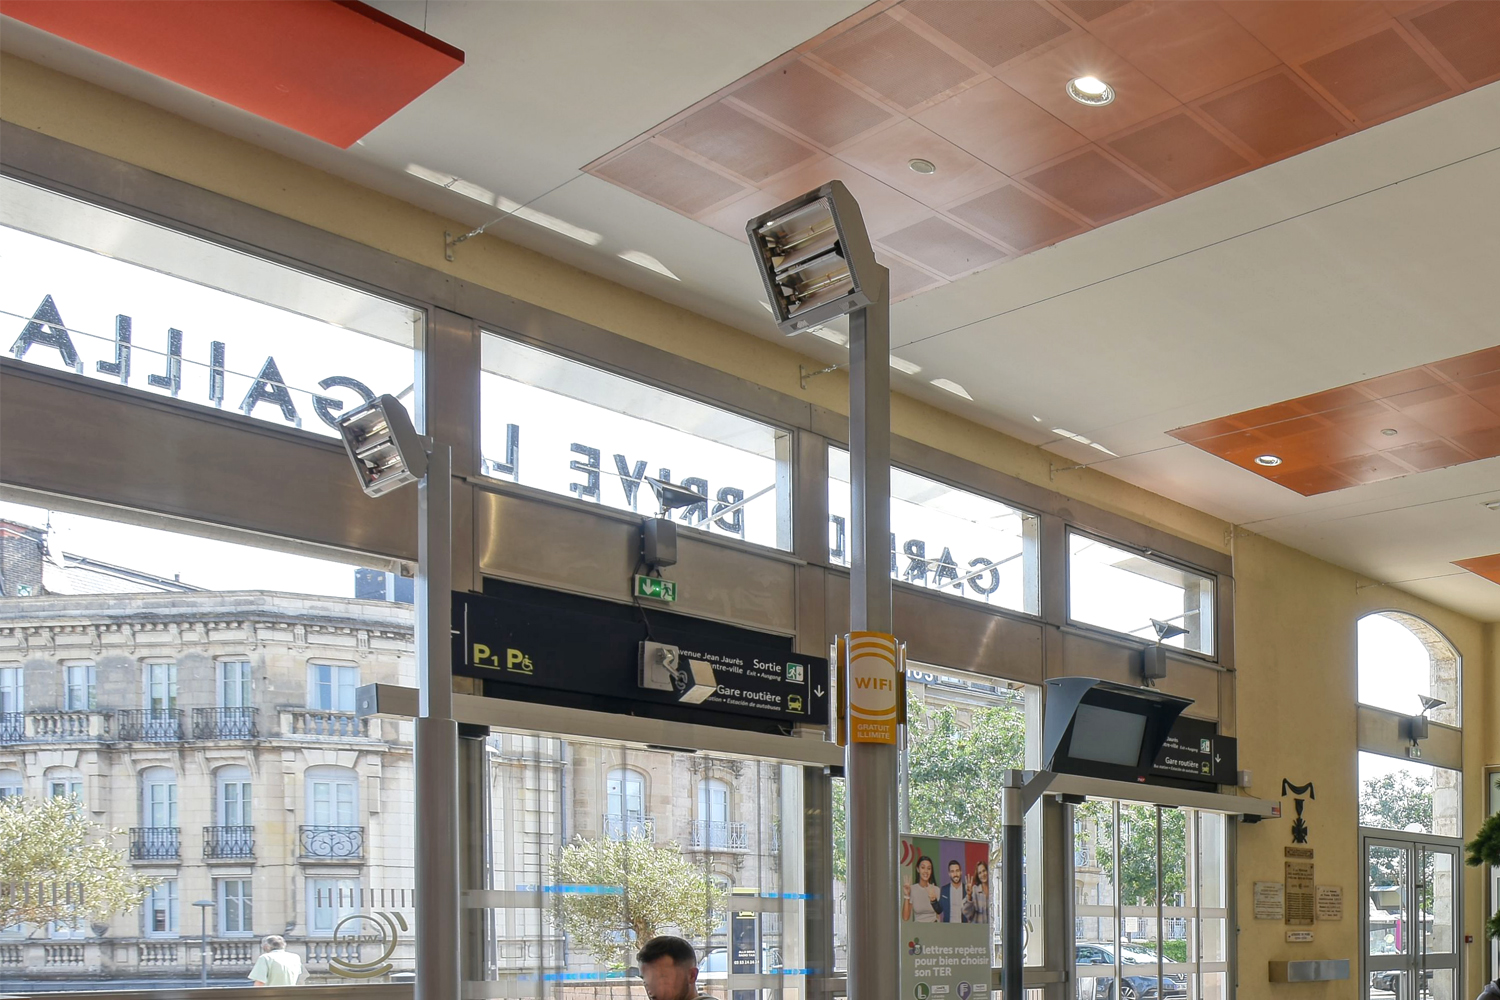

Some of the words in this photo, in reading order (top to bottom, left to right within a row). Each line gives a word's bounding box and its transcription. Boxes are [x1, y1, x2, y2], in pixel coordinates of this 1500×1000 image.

[678, 649, 702, 659] venue
[702, 652, 720, 662] Jean
[720, 655, 744, 666] Jaurès
[711, 663, 744, 675] ntre-ville
[753, 659, 782, 673] Sortie
[746, 669, 757, 677] Exit
[854, 677, 893, 692] WIFI
[716, 684, 741, 697] Gare
[742, 688, 782, 703] routière
[857, 723, 890, 732] GRATUIT
[1164, 756, 1178, 766] Gare
[1178, 759, 1199, 769] routière
[922, 945, 953, 954] lettres
[954, 944, 987, 956] repères
[914, 957, 937, 968] pour
[938, 955, 959, 965] bien
[960, 955, 990, 965] choisir
[914, 969, 931, 977] son
[932, 967, 952, 977] TER
